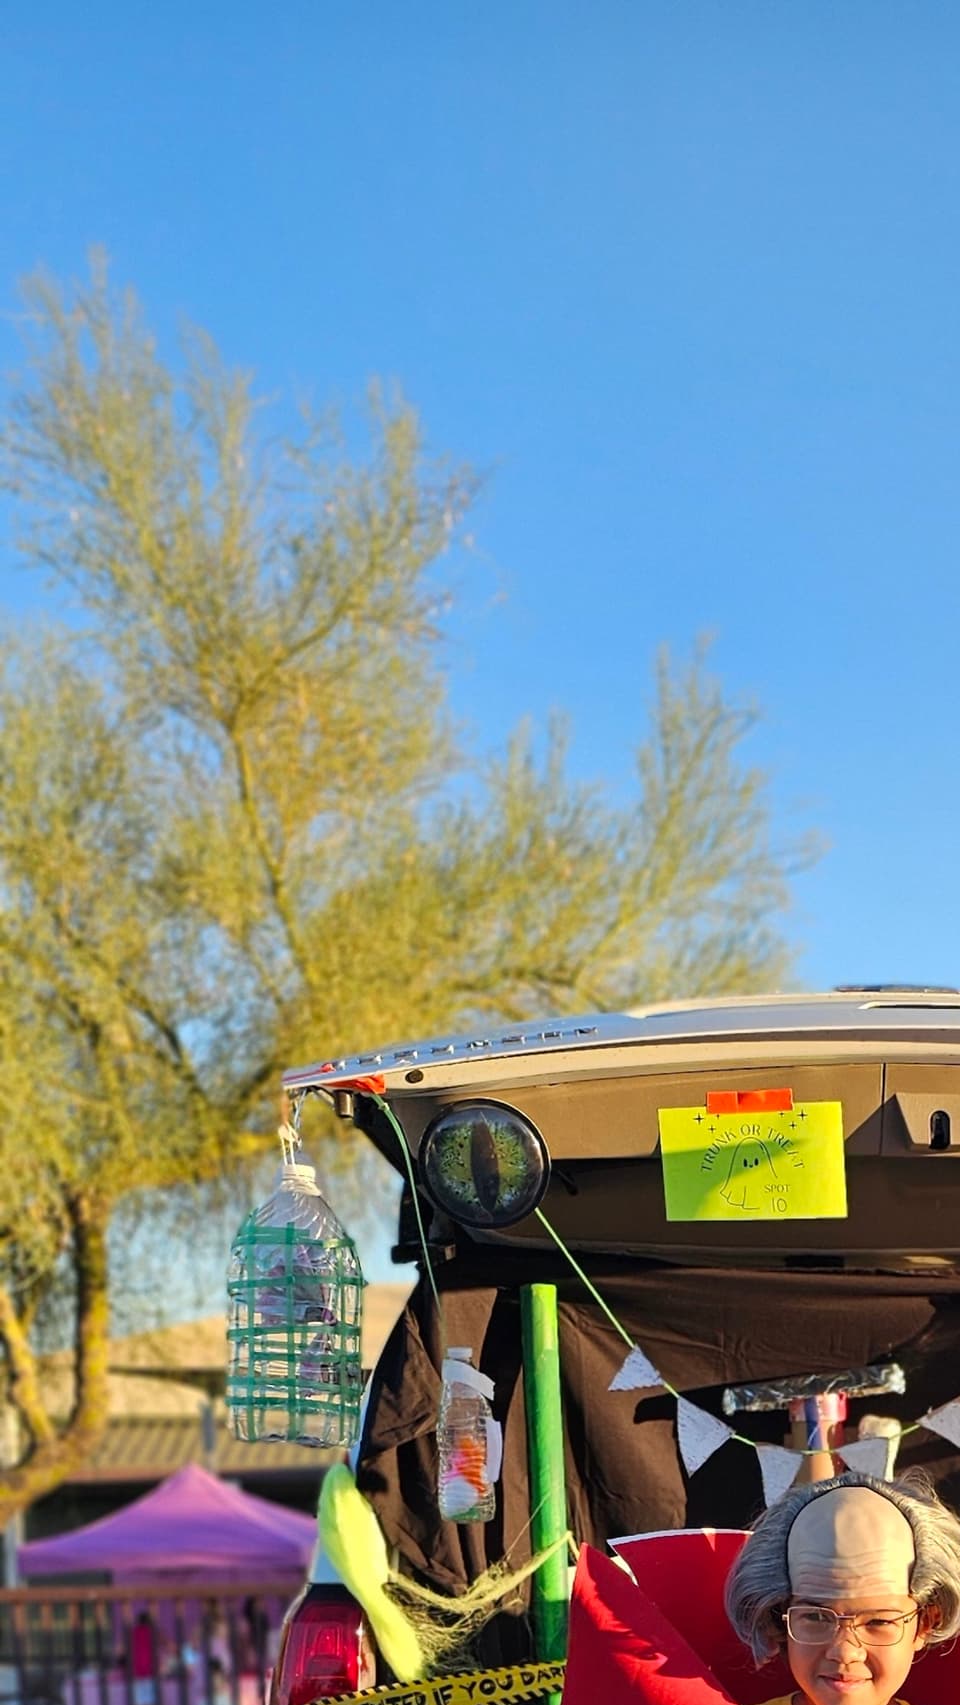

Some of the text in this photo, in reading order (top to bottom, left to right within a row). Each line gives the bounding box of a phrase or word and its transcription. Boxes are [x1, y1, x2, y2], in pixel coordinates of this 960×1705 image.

[701, 1123, 805, 1172] TRUNK OR TREAT
[764, 1184, 791, 1194] SPOT
[771, 1198, 788, 1212] 10
[459, 1674, 514, 1700] YOU
[520, 1664, 566, 1686] DAR
